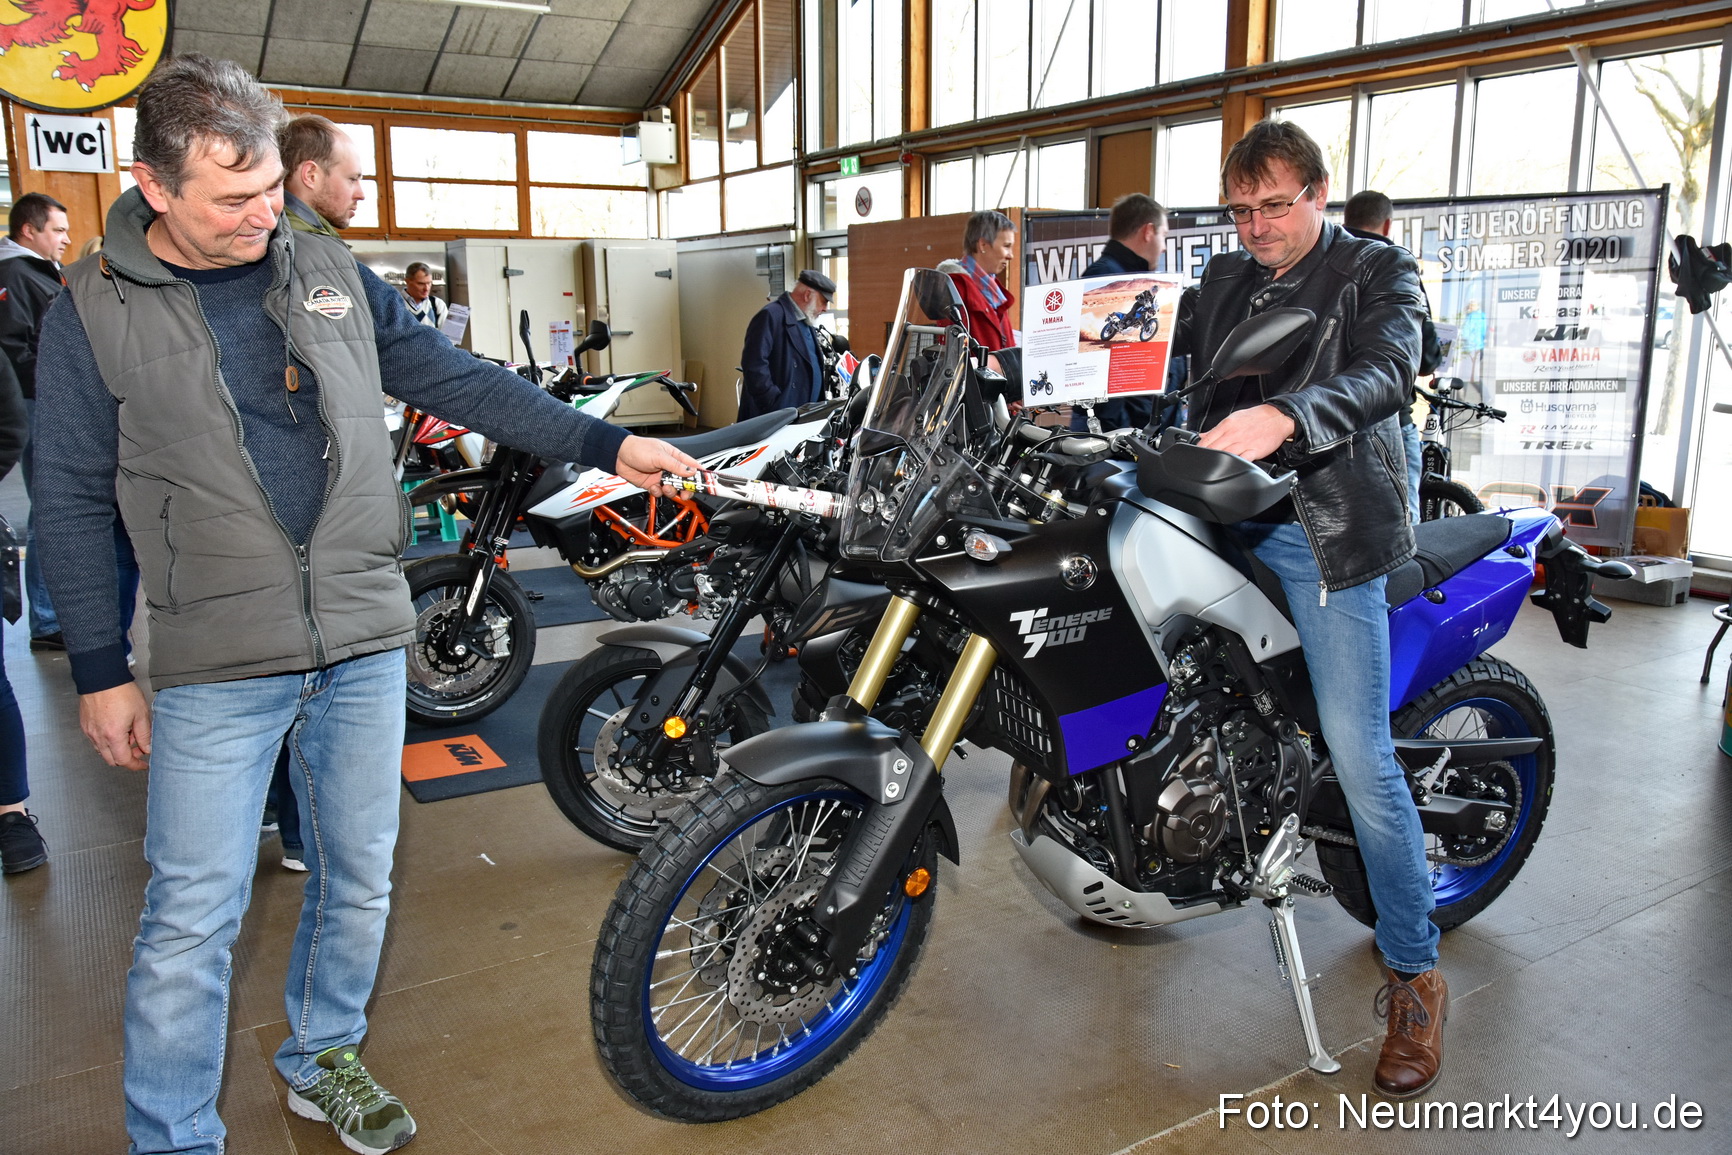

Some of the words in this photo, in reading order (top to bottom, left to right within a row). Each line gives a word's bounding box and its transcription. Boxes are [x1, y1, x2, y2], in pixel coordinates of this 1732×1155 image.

[42, 130, 97, 155] WC
[1438, 200, 1644, 242] NEUERÖFFNUNG
[1437, 241, 1545, 273] SOMMER
[1554, 236, 1622, 266] 2020
[1501, 288, 1536, 301] UNSERE
[1042, 315, 1064, 325] YAMAHA
[1533, 324, 1590, 342] KTM
[1540, 347, 1601, 362] YAMAHA
[1502, 381, 1537, 392] UNSERE
[1539, 380, 1618, 392] FAHRRADMARKEN
[1535, 401, 1597, 415] Husqvarna
[1519, 440, 1595, 450] TREK
[1023, 625, 1088, 659] 700
[444, 743, 484, 766] KTM
[838, 808, 896, 888] YAMAHA
